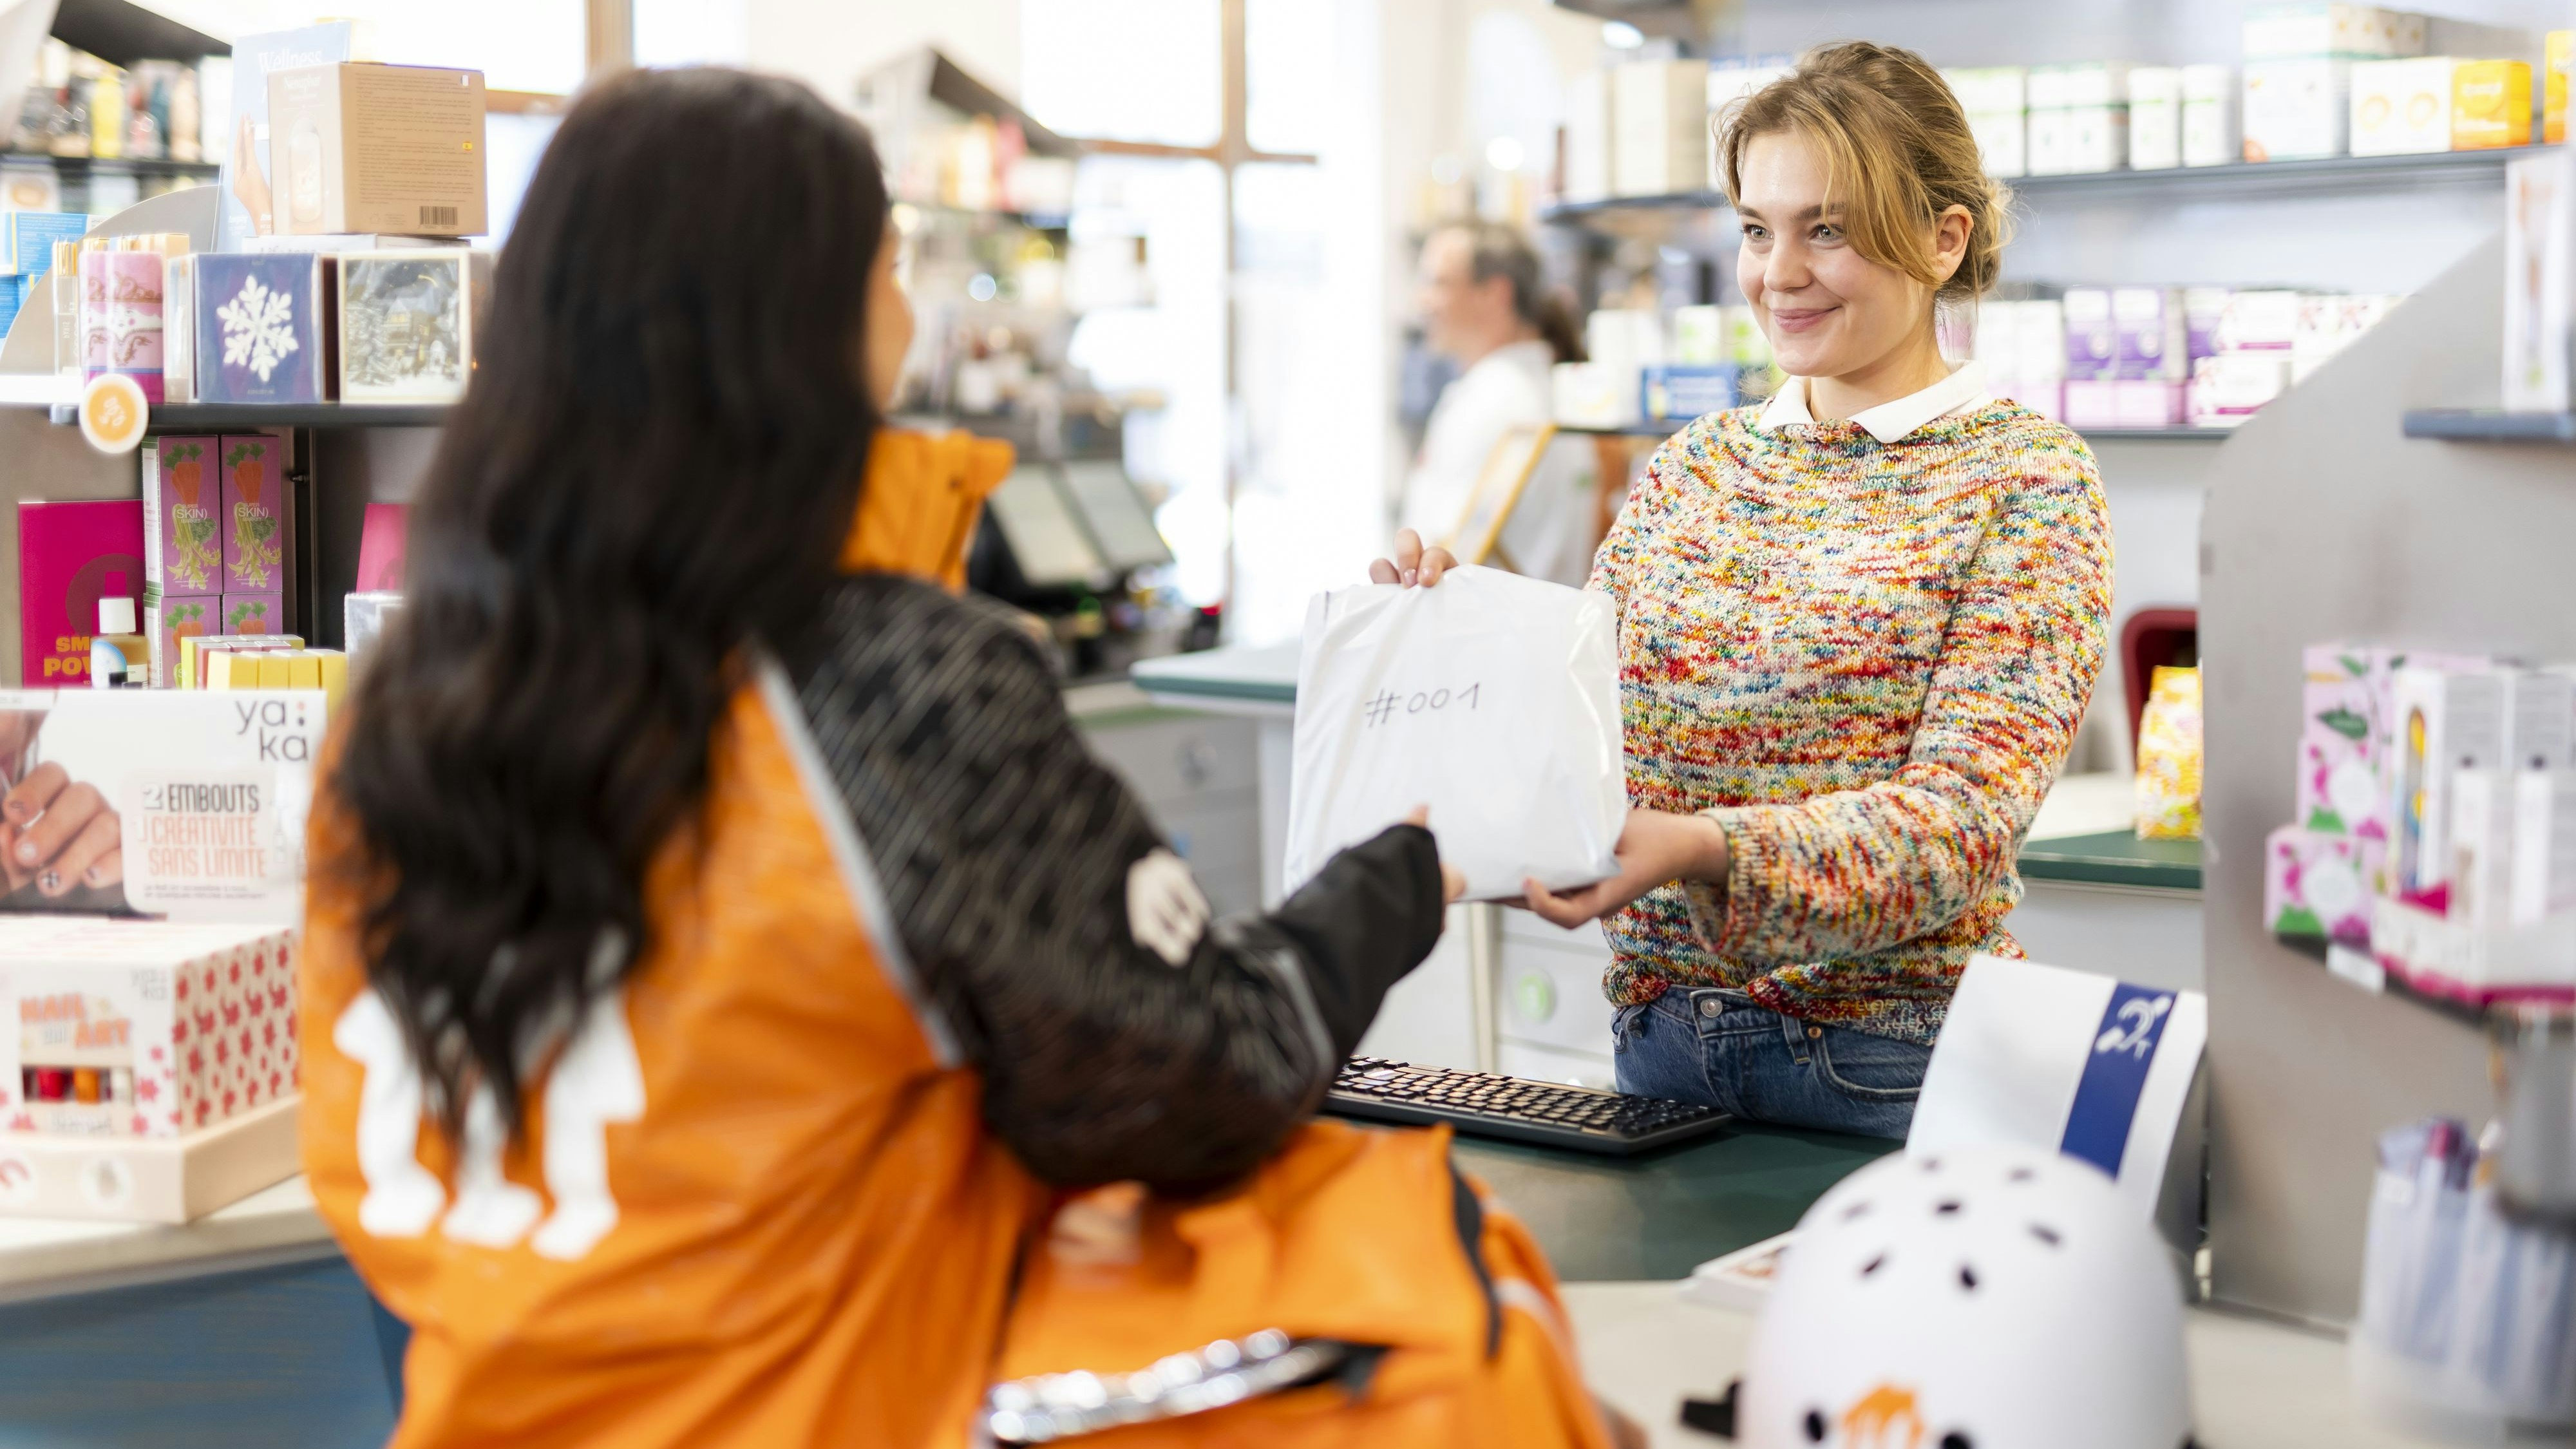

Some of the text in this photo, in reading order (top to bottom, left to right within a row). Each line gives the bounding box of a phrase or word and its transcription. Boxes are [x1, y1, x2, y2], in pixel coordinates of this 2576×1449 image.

[259, 48, 322, 74] Wellness
[55, 636, 90, 652] SM
[1365, 682, 1479, 728] #001
[260, 726, 308, 761] ka
[167, 783, 260, 813] EMBOUTS
